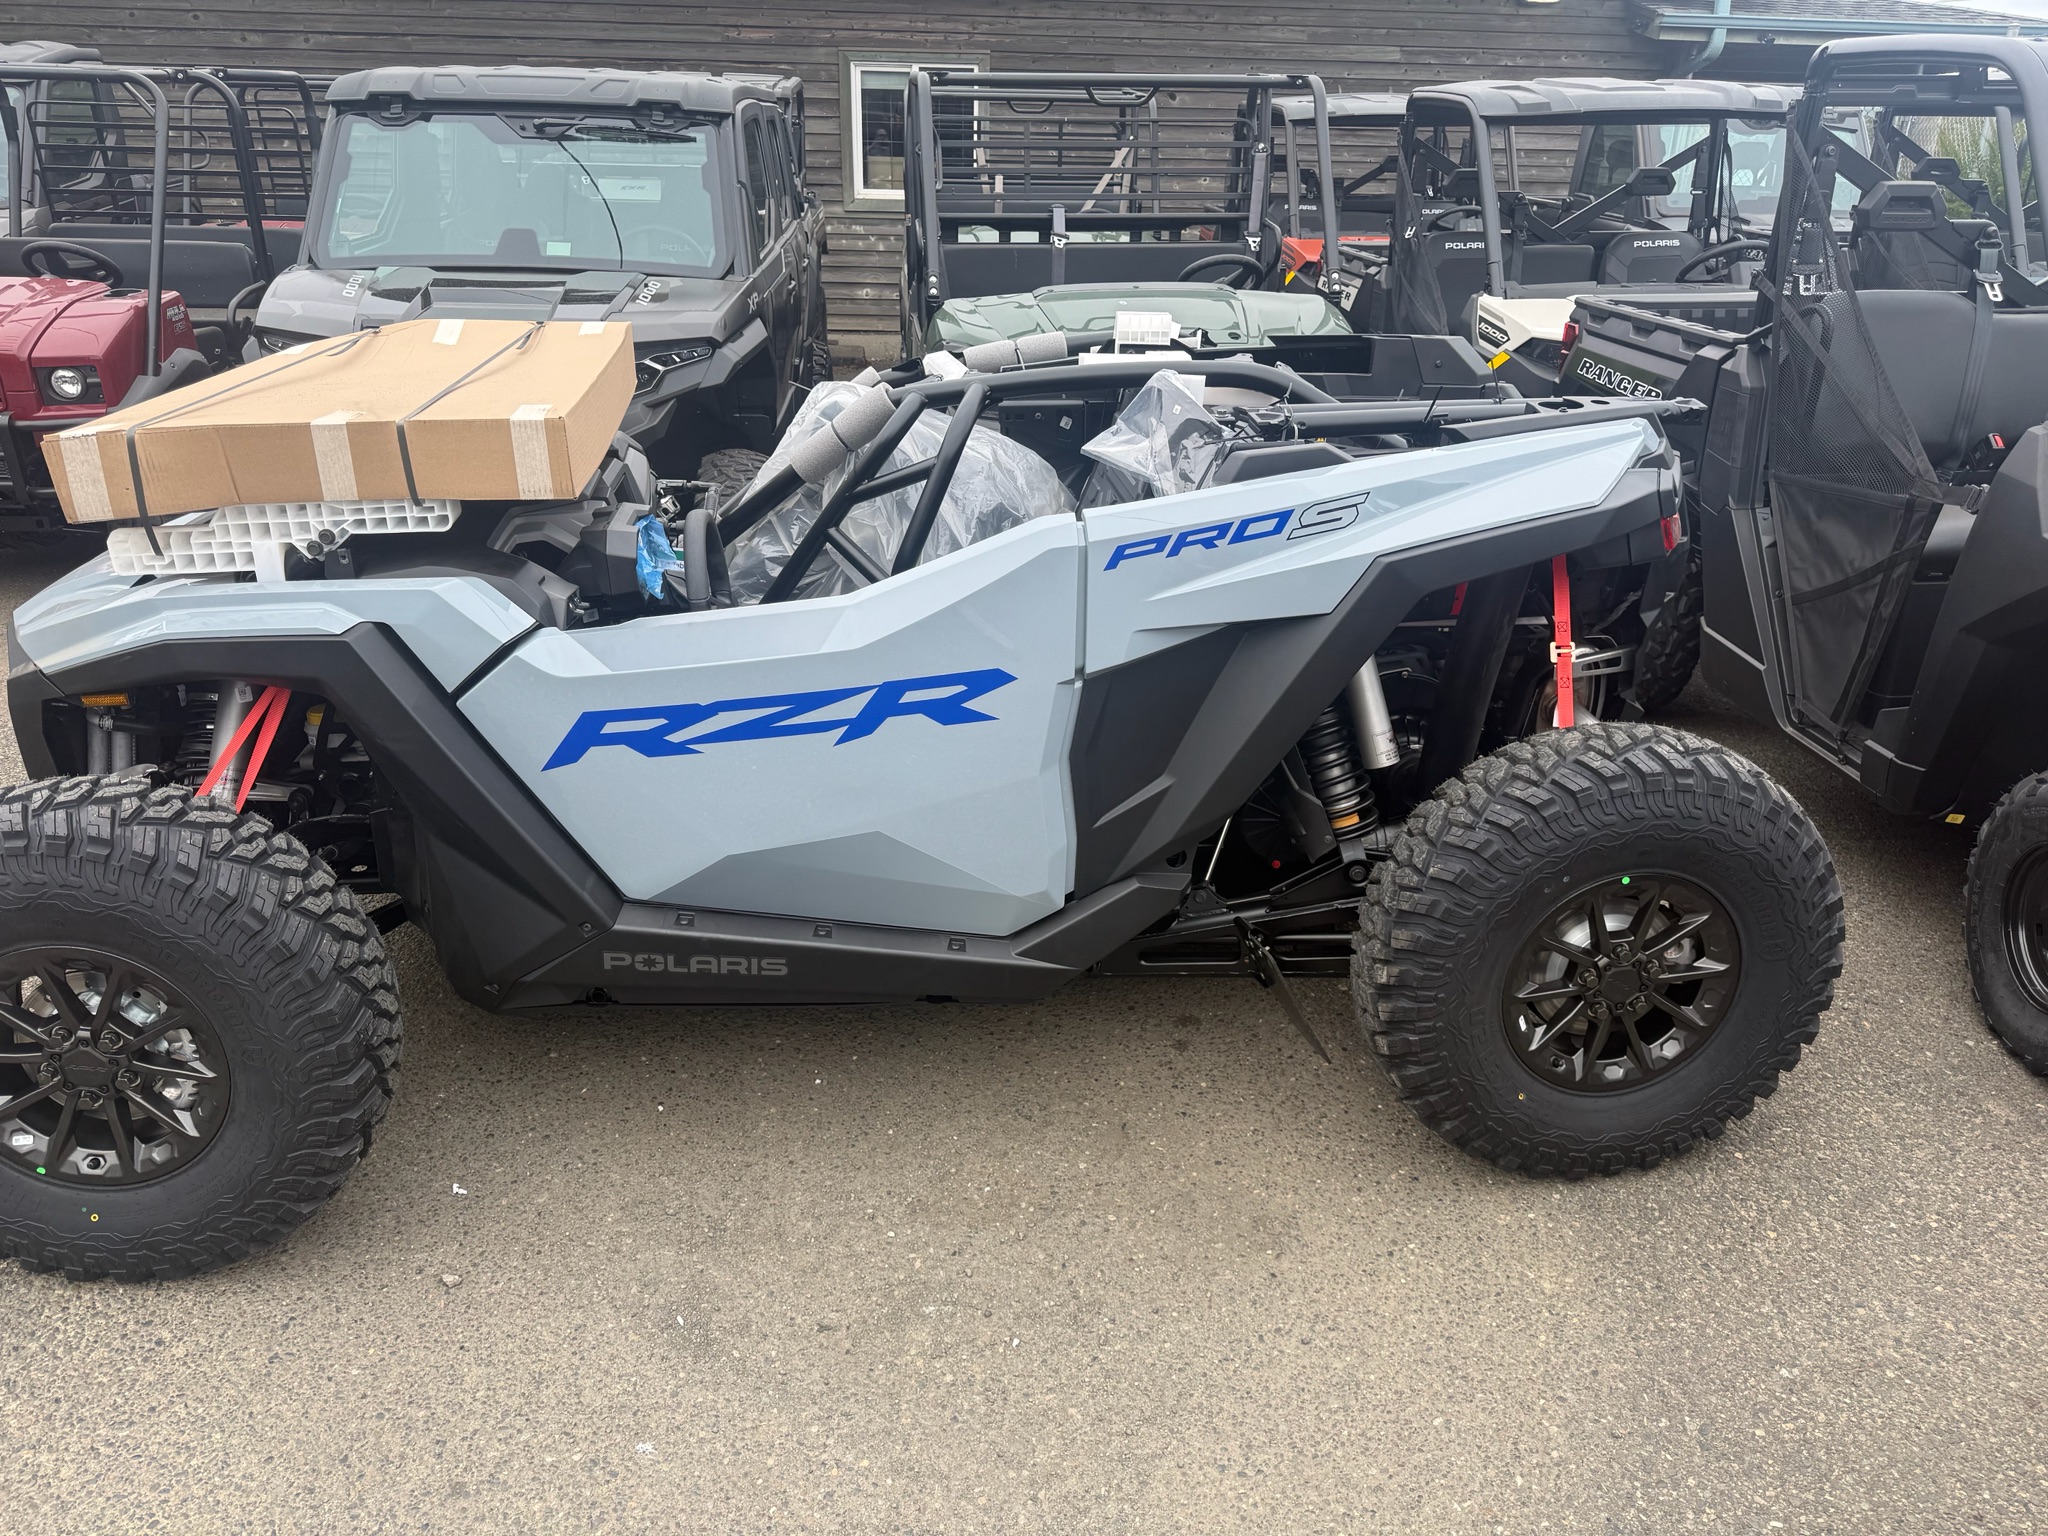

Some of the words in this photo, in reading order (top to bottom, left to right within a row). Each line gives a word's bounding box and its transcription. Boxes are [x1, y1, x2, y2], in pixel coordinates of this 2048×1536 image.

[1633, 239, 1680, 247] POLARIS
[341, 274, 365, 297] 1000
[635, 280, 661, 307] 1000
[747, 291, 759, 315] XP
[1479, 322, 1508, 342] 1000
[1577, 358, 1662, 399] RANGER
[1103, 508, 1295, 571] PRO
[1287, 491, 1370, 540] S
[540, 667, 1019, 772] RZR
[603, 952, 789, 976] POLARIS
